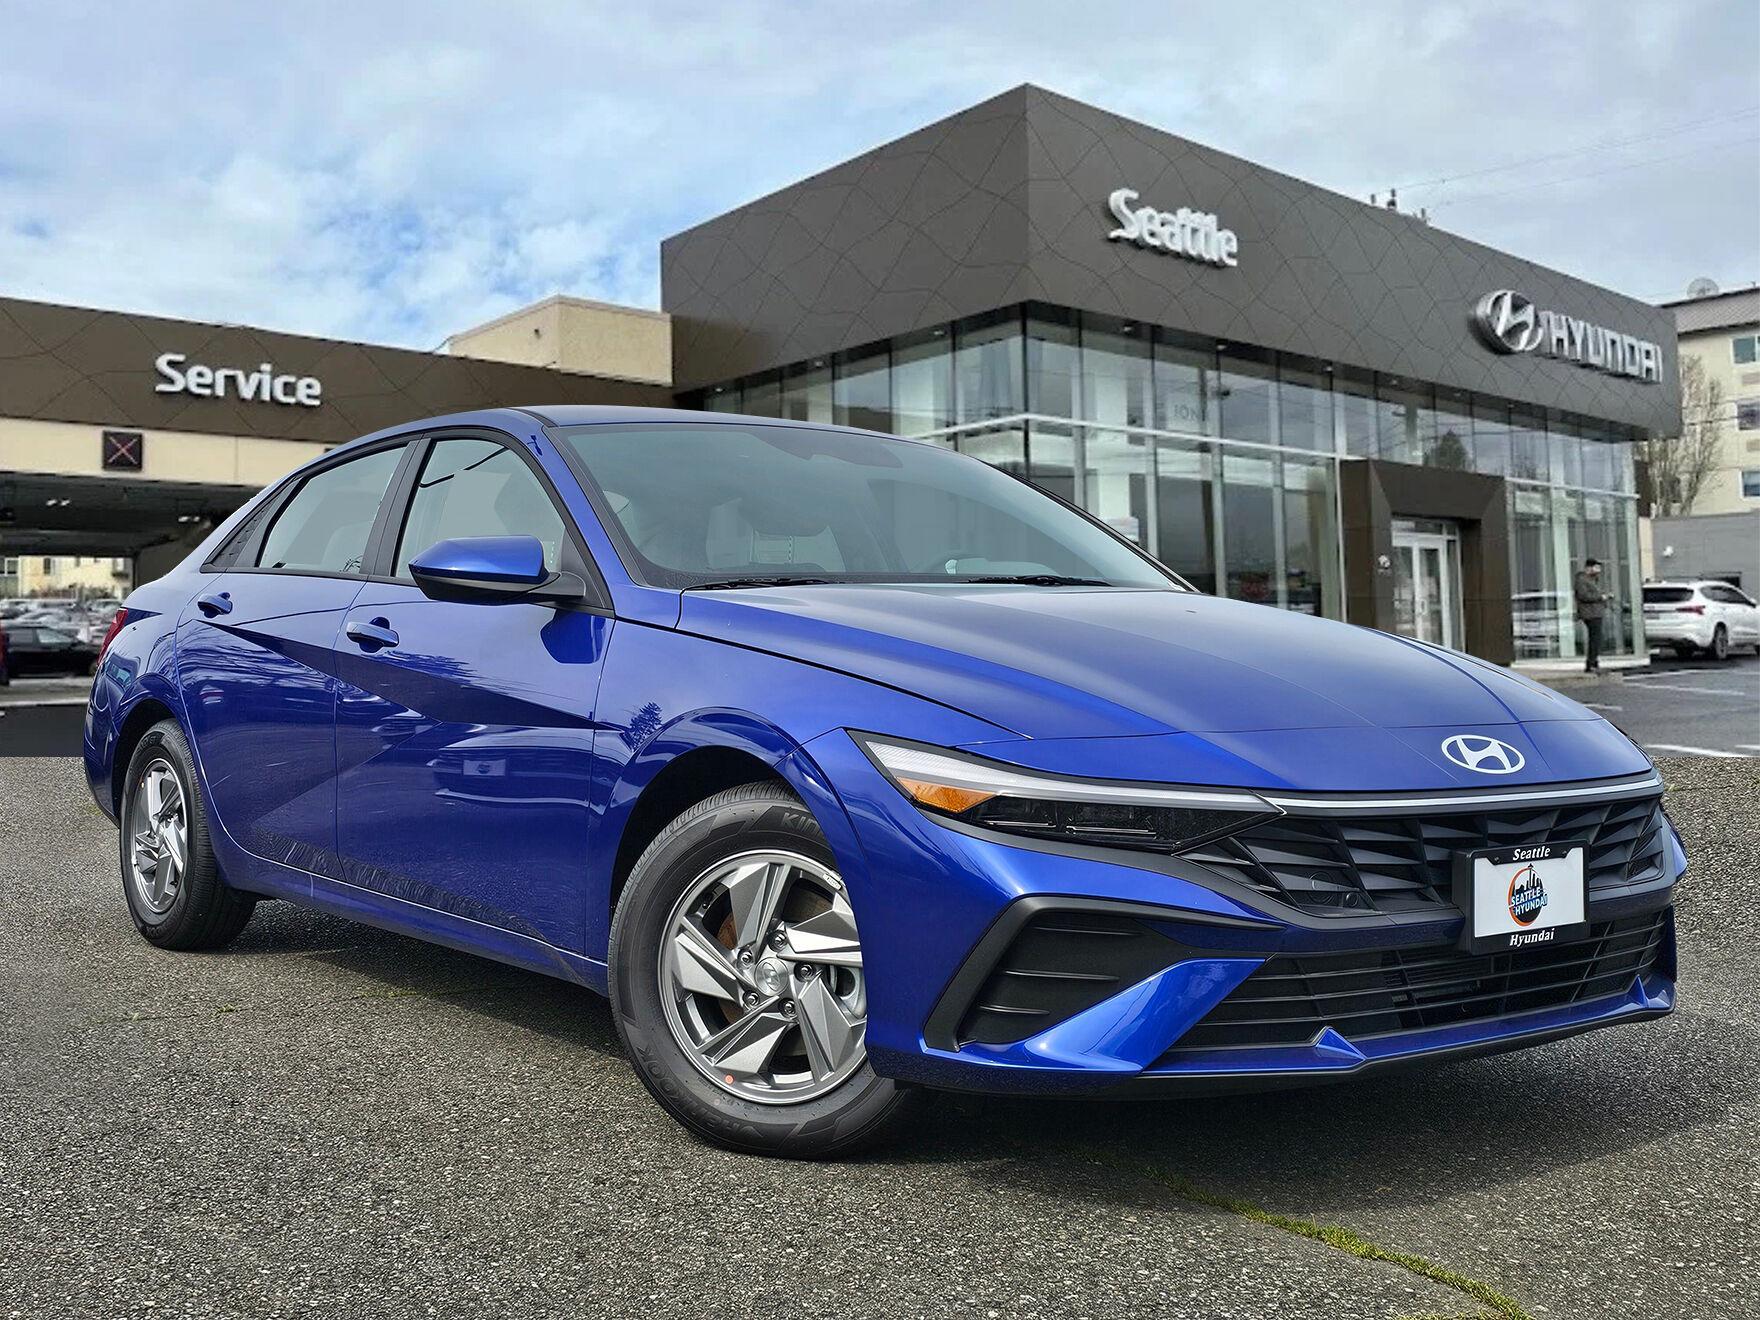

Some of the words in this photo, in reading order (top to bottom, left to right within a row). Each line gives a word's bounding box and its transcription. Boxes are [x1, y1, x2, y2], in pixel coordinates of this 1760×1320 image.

[1107, 188, 1239, 267] Seattle
[1539, 311, 1664, 384] HYUNDAI
[154, 353, 322, 406] Service
[1511, 845, 1551, 862] Seattle
[1510, 886, 1541, 907] SEATTLE
[1514, 893, 1549, 916] HYUNDAI
[1508, 927, 1556, 947] Hyundai
